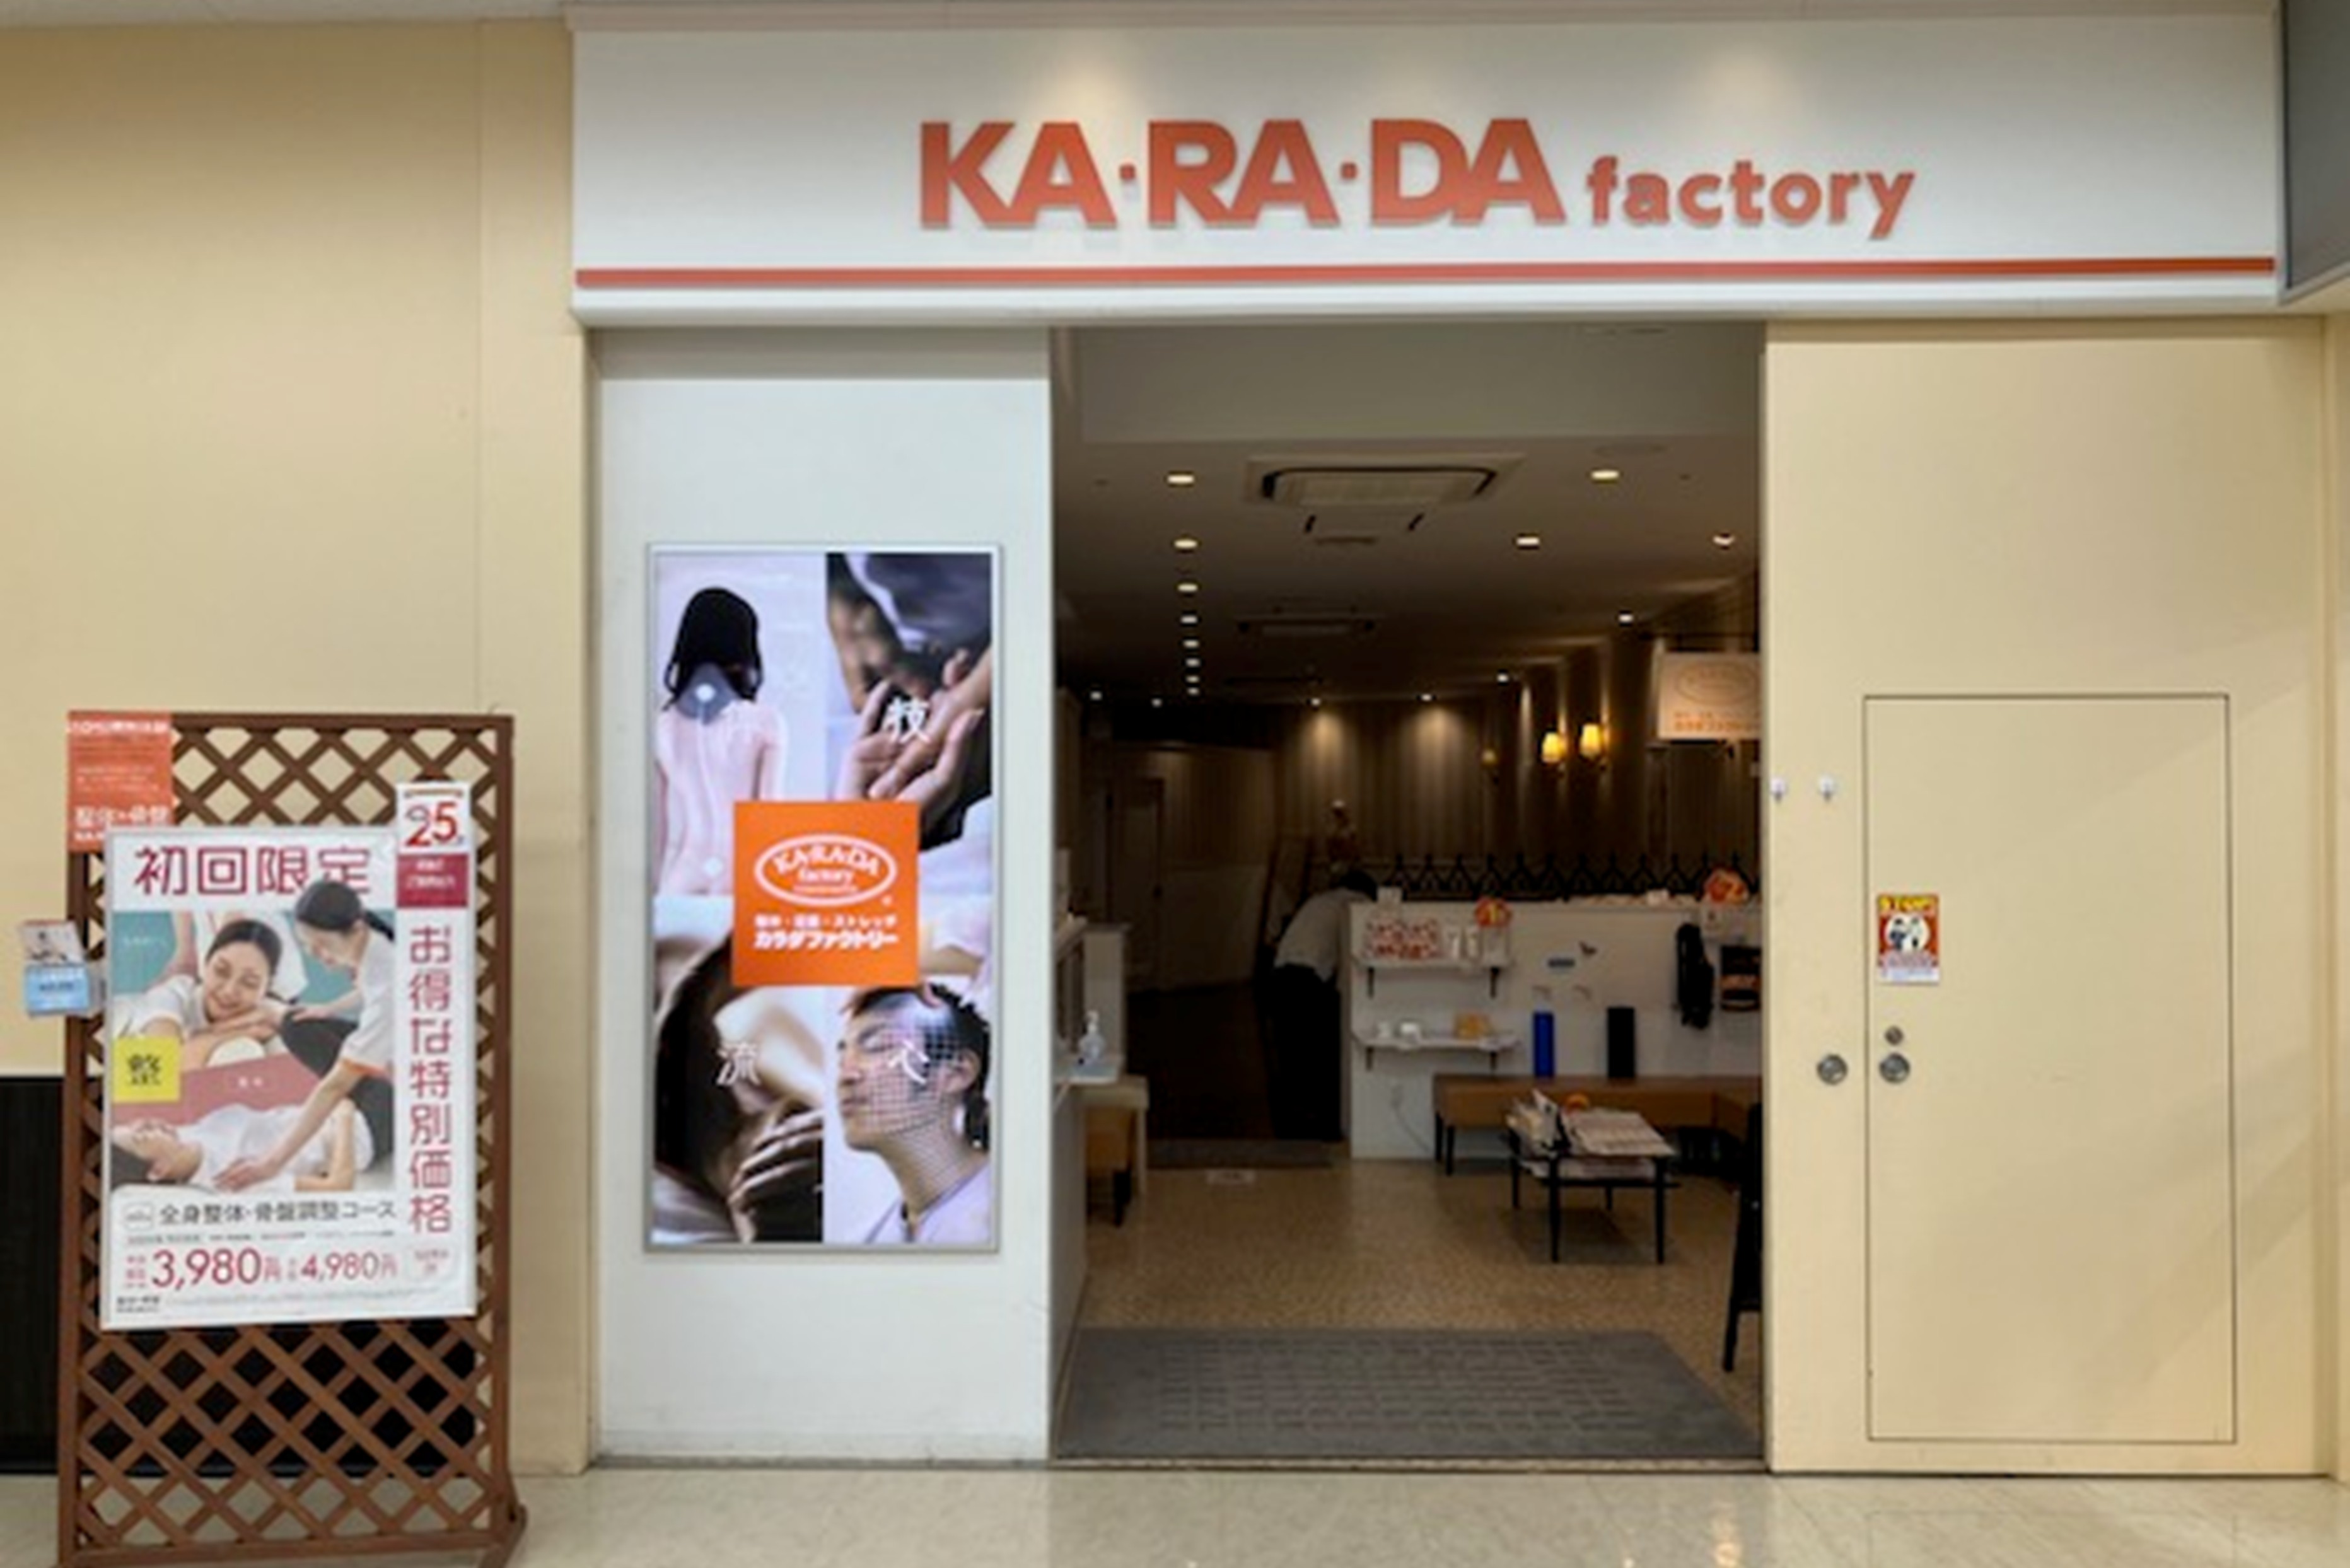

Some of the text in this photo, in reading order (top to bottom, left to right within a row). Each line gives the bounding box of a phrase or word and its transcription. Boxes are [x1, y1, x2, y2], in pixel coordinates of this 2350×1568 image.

[1586, 155, 1917, 240] factory
[134, 847, 371, 894] 初回限定
[409, 925, 451, 1234] お得な特別価格
